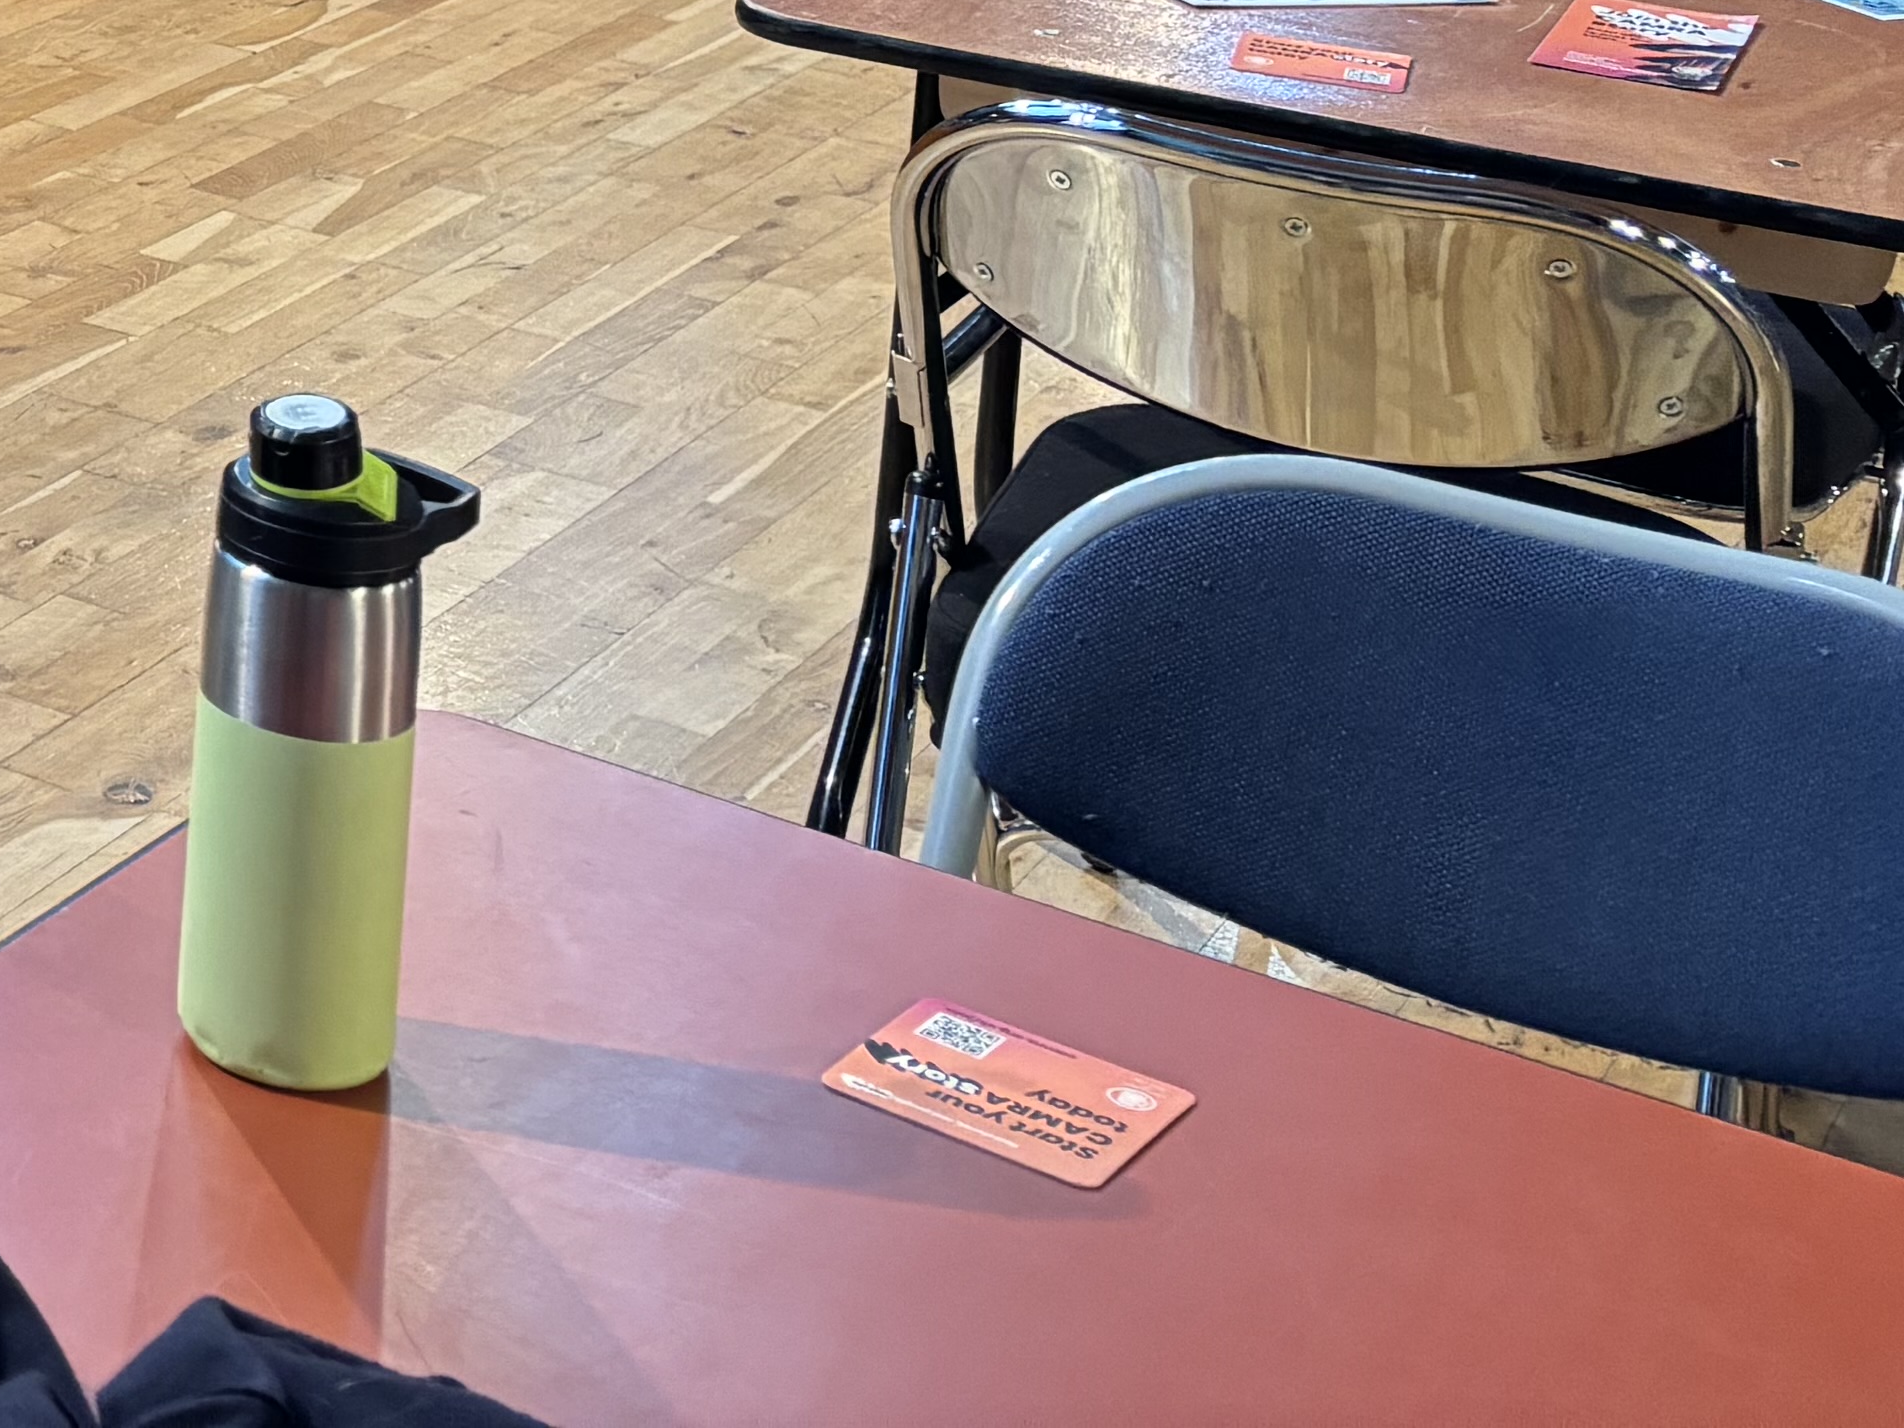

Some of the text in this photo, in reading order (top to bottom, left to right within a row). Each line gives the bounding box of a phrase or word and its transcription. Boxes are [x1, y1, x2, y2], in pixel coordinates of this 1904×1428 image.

[886, 1053, 981, 1095] story
[926, 1089, 1007, 1125] your
[987, 1091, 1114, 1145] CAMRA
[1024, 1089, 1130, 1133] today
[1010, 1122, 1099, 1160] Start
